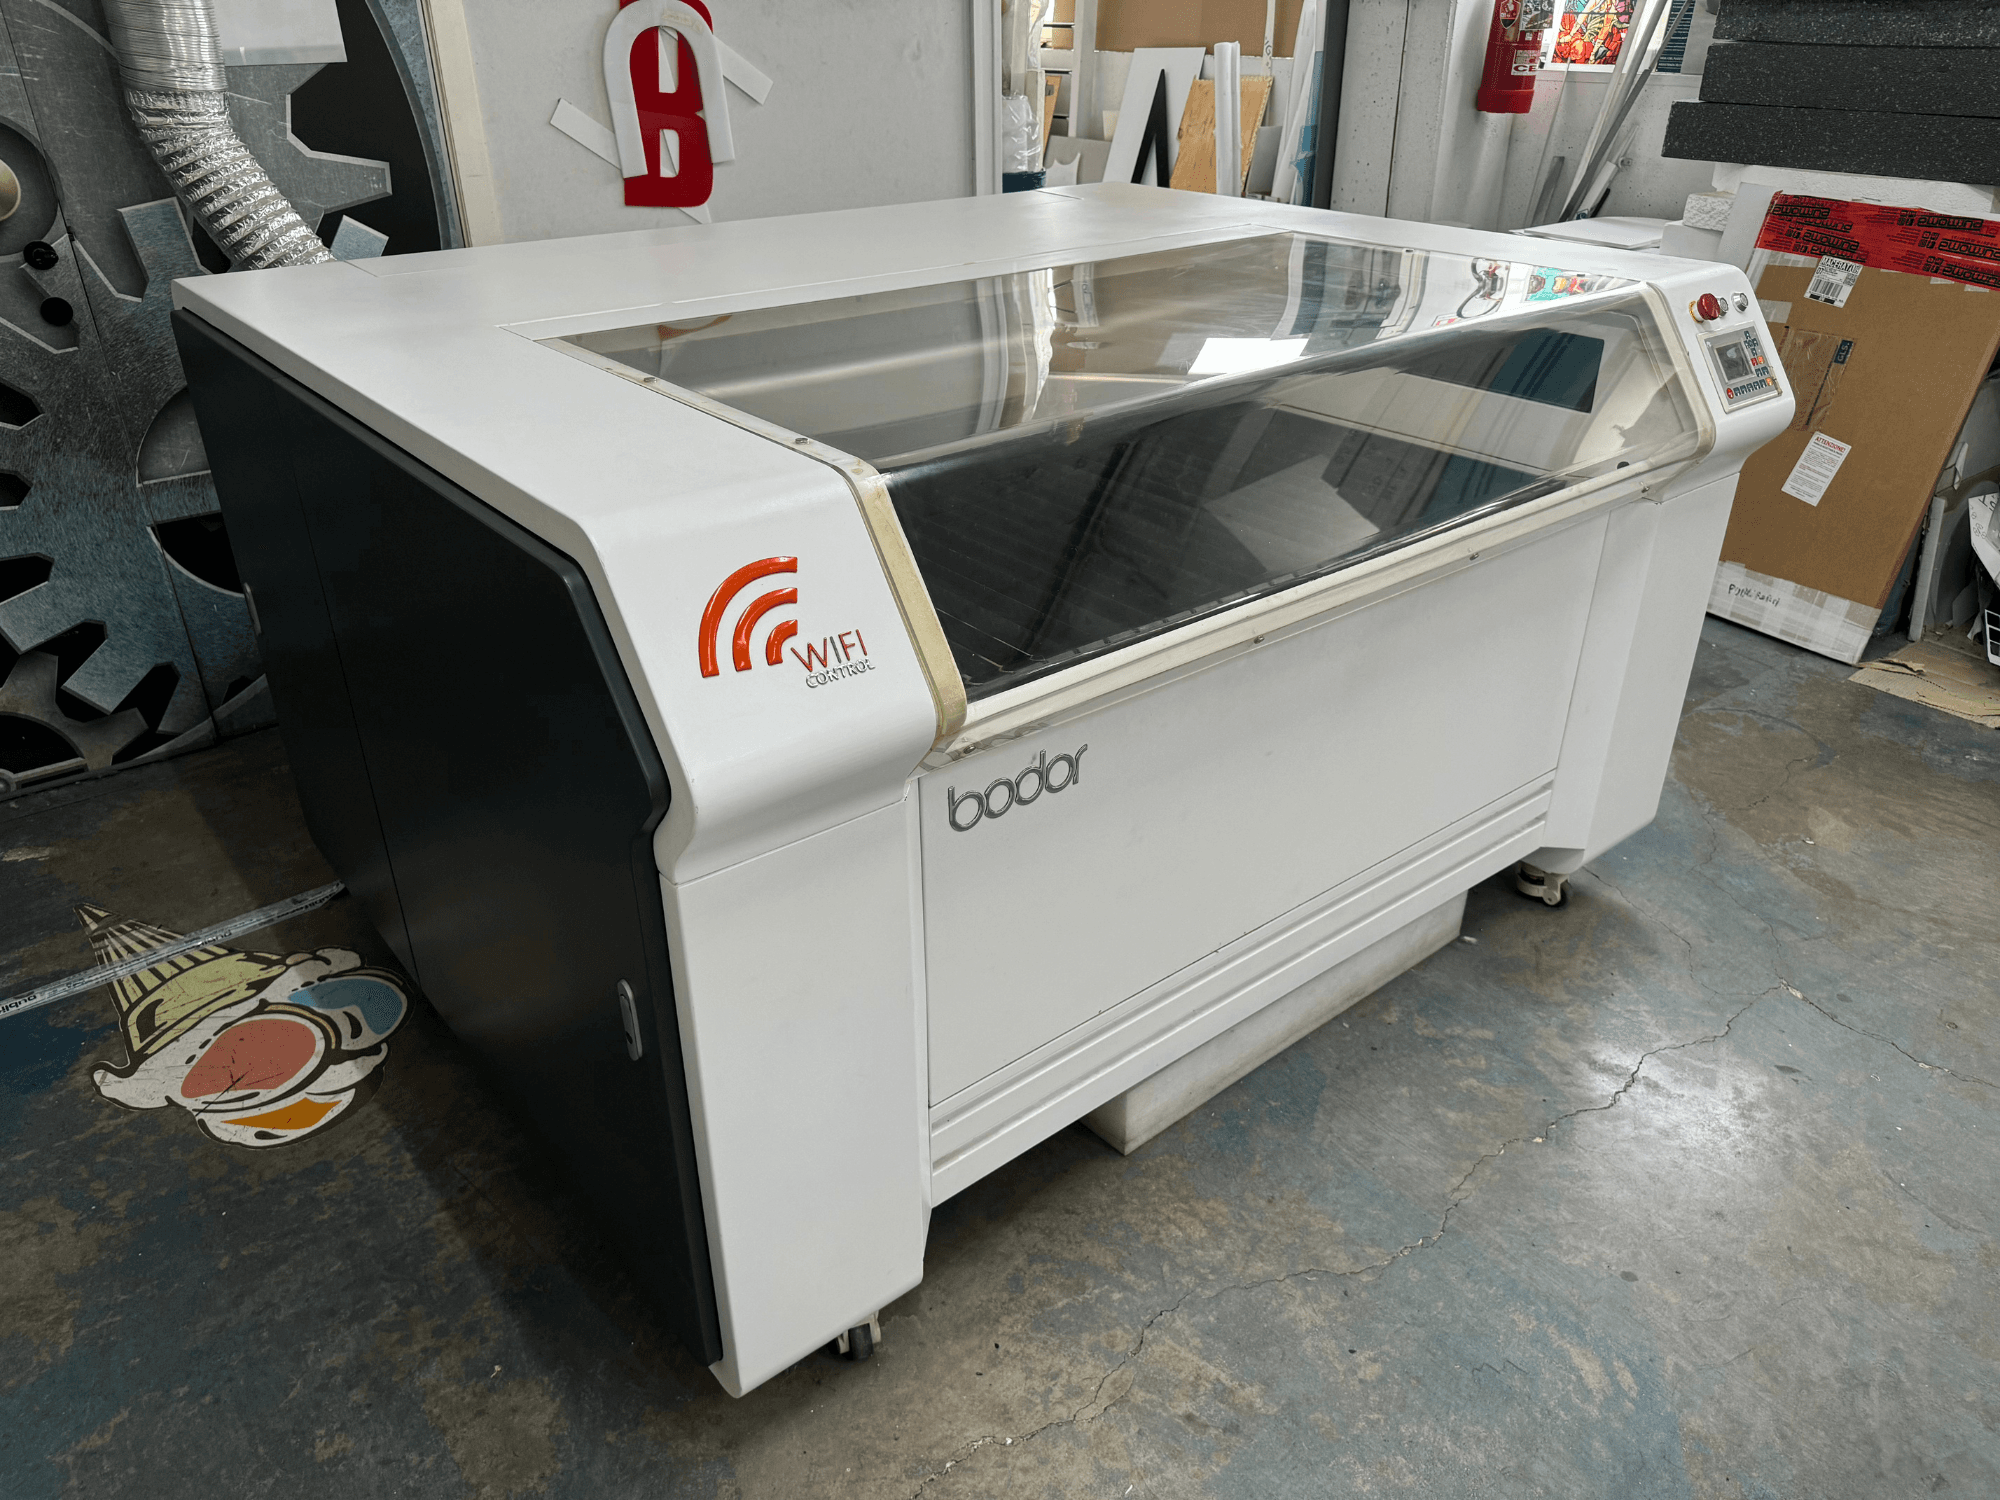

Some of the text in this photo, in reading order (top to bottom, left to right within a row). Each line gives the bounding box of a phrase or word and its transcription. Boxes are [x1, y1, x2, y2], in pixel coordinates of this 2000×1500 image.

[790, 629, 868, 672] WIFI
[806, 658, 876, 688] CONTROL
[947, 743, 1088, 832] bodor
